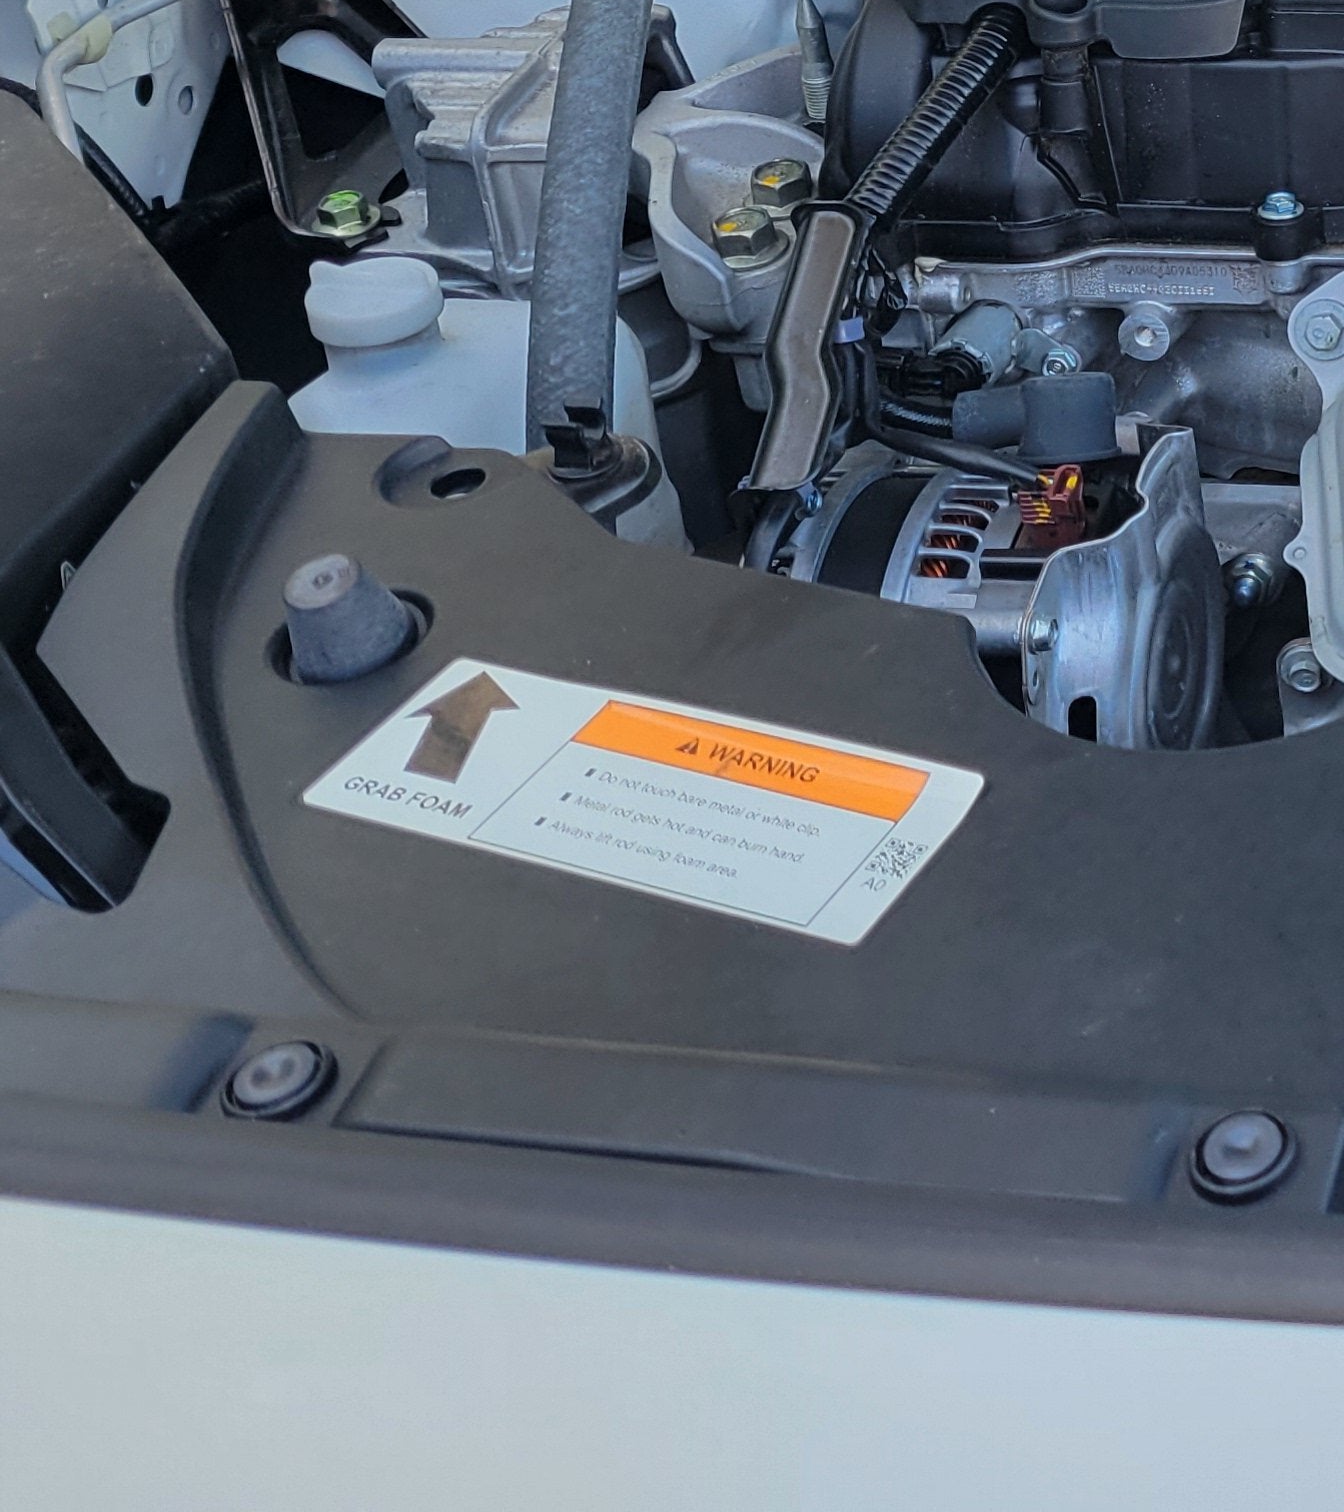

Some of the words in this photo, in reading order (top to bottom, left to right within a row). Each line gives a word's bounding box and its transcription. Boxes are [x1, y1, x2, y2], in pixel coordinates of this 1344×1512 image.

[708, 742, 820, 784] WARNING
[344, 776, 407, 801] GRAB
[405, 792, 473, 818] FOAM
[598, 771, 618, 784] Do
[620, 778, 642, 790] not
[641, 783, 676, 797] touch
[678, 791, 707, 806] bare
[709, 801, 744, 817] metal
[745, 810, 761, 820] or
[762, 815, 795, 830] white
[550, 820, 594, 839] Always
[614, 839, 638, 850] rod
[636, 845, 671, 862] using
[673, 852, 706, 868] foam
[574, 795, 610, 811] Metal
[611, 806, 635, 818] rod
[630, 812, 661, 826] gets
[662, 818, 685, 832] hot
[685, 827, 713, 839] and
[712, 834, 736, 846] can
[737, 838, 768, 854] burn
